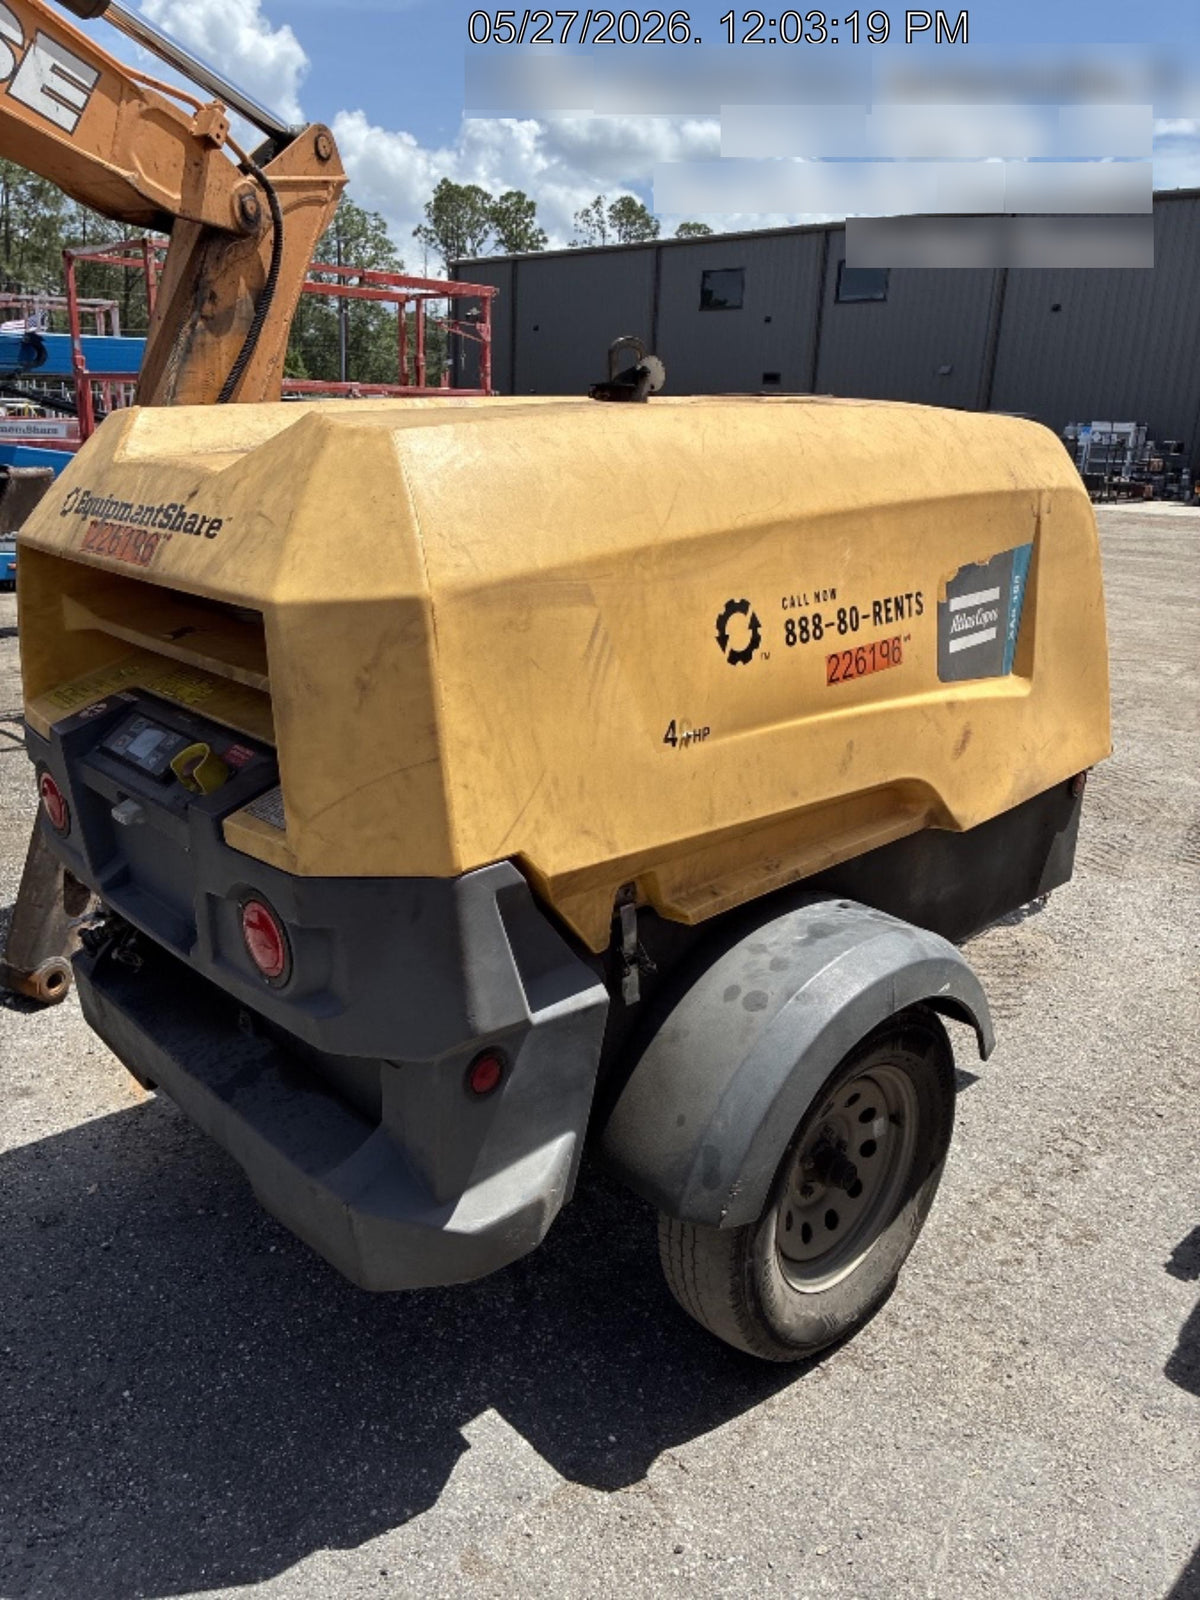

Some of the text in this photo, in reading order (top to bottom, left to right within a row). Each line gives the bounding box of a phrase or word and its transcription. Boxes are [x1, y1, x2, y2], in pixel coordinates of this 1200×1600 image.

[75, 490, 223, 539] EquipmentShare
[782, 588, 837, 610] CALL NOW
[784, 591, 924, 647] 888-80-RENTS
[826, 637, 901, 684] 226196
